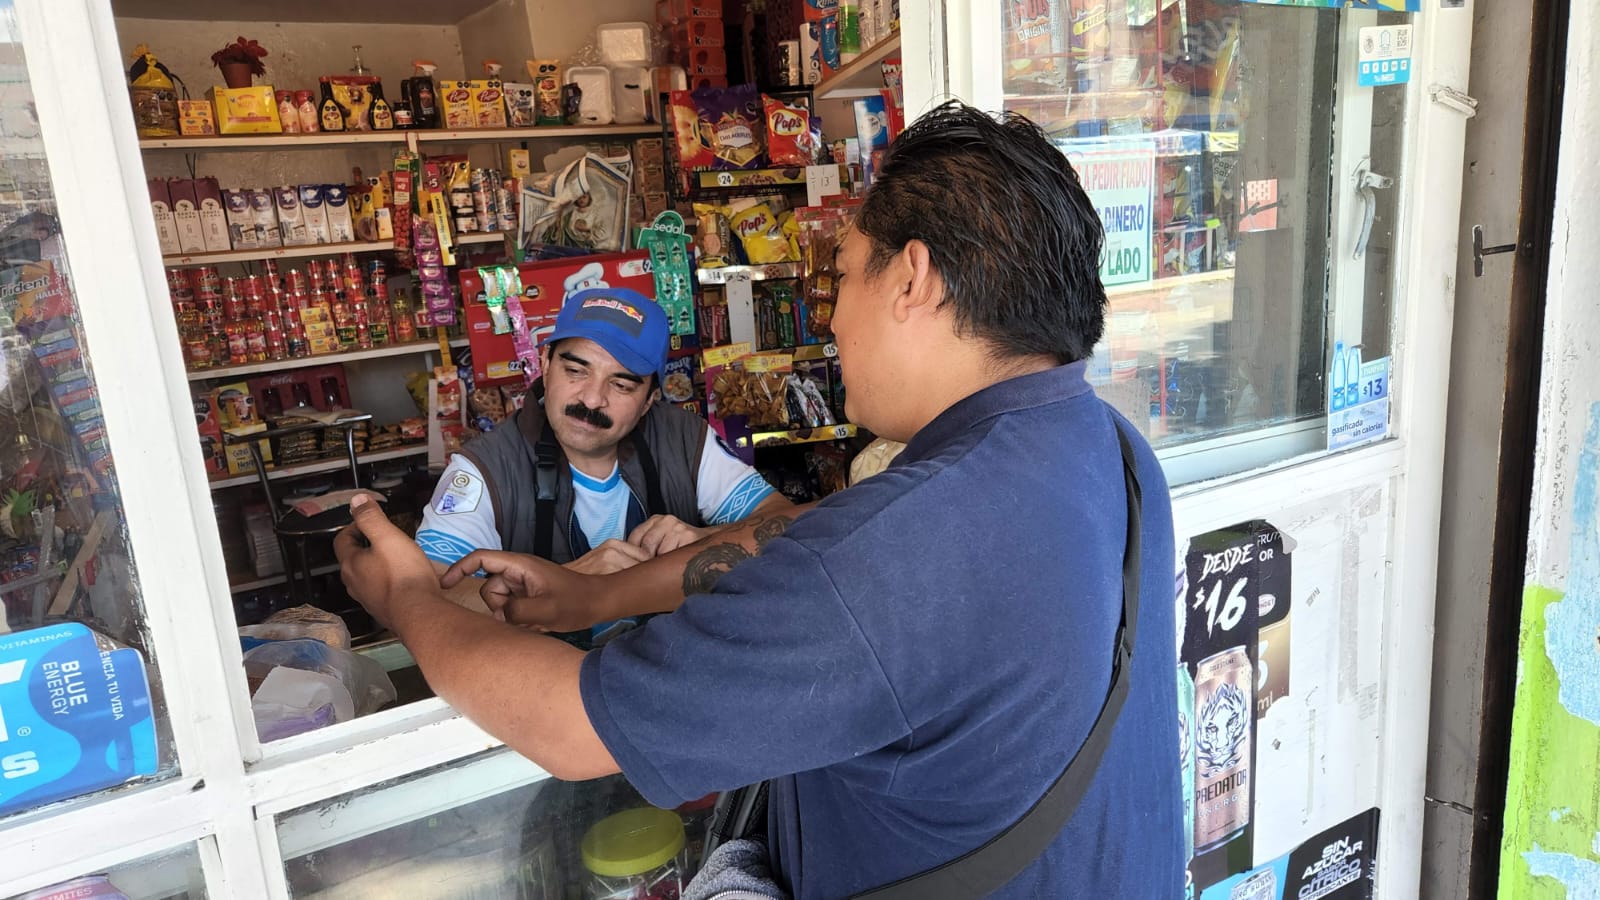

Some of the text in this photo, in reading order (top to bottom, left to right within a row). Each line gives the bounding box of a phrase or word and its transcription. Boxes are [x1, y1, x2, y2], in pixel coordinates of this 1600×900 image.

[771, 112, 803, 131] Pap's
[1093, 161, 1118, 190] PEDIR
[1122, 161, 1147, 189] FIADO
[654, 223, 682, 234] sedal
[738, 213, 767, 237] Pap's
[1105, 203, 1144, 233] DINERO
[1108, 246, 1141, 276] LADO
[0, 275, 50, 298] Trident
[1363, 379, 1382, 397] $13
[1331, 419, 1364, 436] gasificada
[1197, 544, 1254, 583] DESDE
[1193, 577, 1248, 640] $16
[0, 631, 73, 650] VITAMINAS
[43, 661, 70, 715] ENERGY
[61, 660, 89, 706] BLUE
[107, 681, 119, 694] TU
[110, 694, 125, 721] VIDA
[1195, 769, 1247, 804] PREDATOR
[1302, 840, 1363, 879] AZÚCAR
[1321, 836, 1349, 858] SIN
[1298, 858, 1360, 898] CÍTRICO
[1317, 861, 1346, 878] SABOR
[1298, 872, 1361, 900] EFRESCANTE
